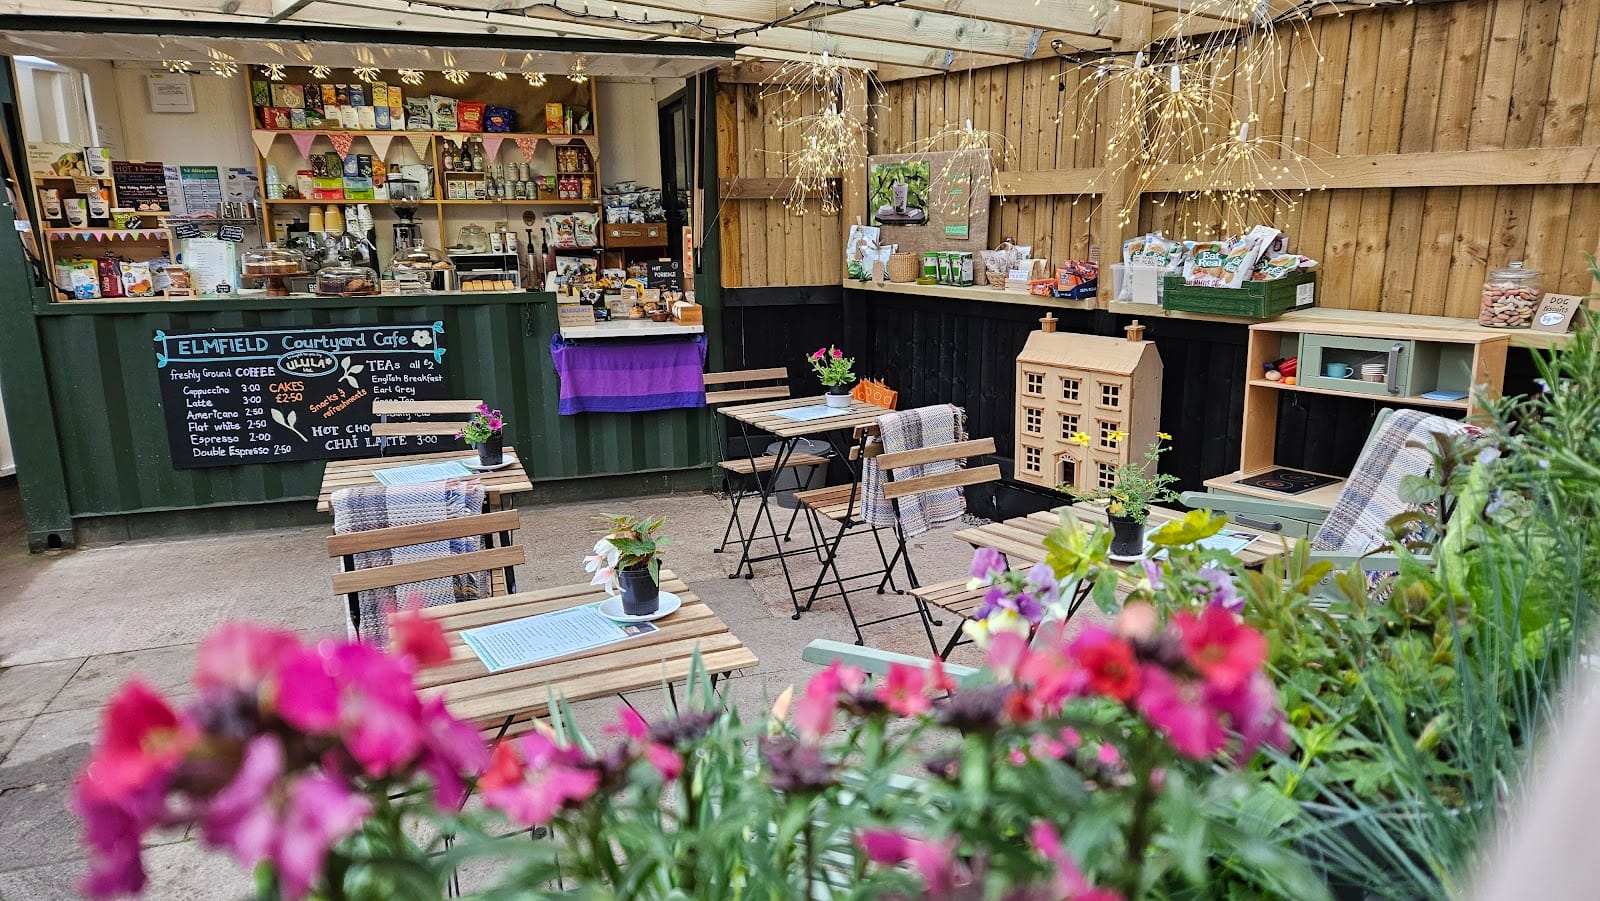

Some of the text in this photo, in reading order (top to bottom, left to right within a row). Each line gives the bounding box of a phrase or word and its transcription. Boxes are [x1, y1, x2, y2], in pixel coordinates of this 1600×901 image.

[1198, 259, 1222, 267] Real
[1550, 297, 1569, 305] DOG
[179, 331, 408, 354] ELMFIELD Courtyard Cafe
[286, 358, 325, 370] ULULA
[409, 360, 420, 369] all
[170, 367, 276, 382] freshly Ground COFFEE
[372, 373, 443, 384] English Breakfast
[183, 385, 230, 398] Cappuccino
[269, 381, 304, 393] CAKES
[373, 385, 416, 395] Earl Grey
[186, 399, 213, 408] Latte
[309, 392, 339, 413] Snacks
[323, 388, 368, 419] refreshments
[186, 410, 239, 420] Americano
[188, 422, 209, 432] Flat
[214, 422, 240, 431] white
[311, 425, 340, 437] HOT
[190, 434, 239, 446] Espresso
[325, 435, 359, 450] CHAI
[193, 447, 226, 457] Double
[228, 446, 269, 457] Espresso
